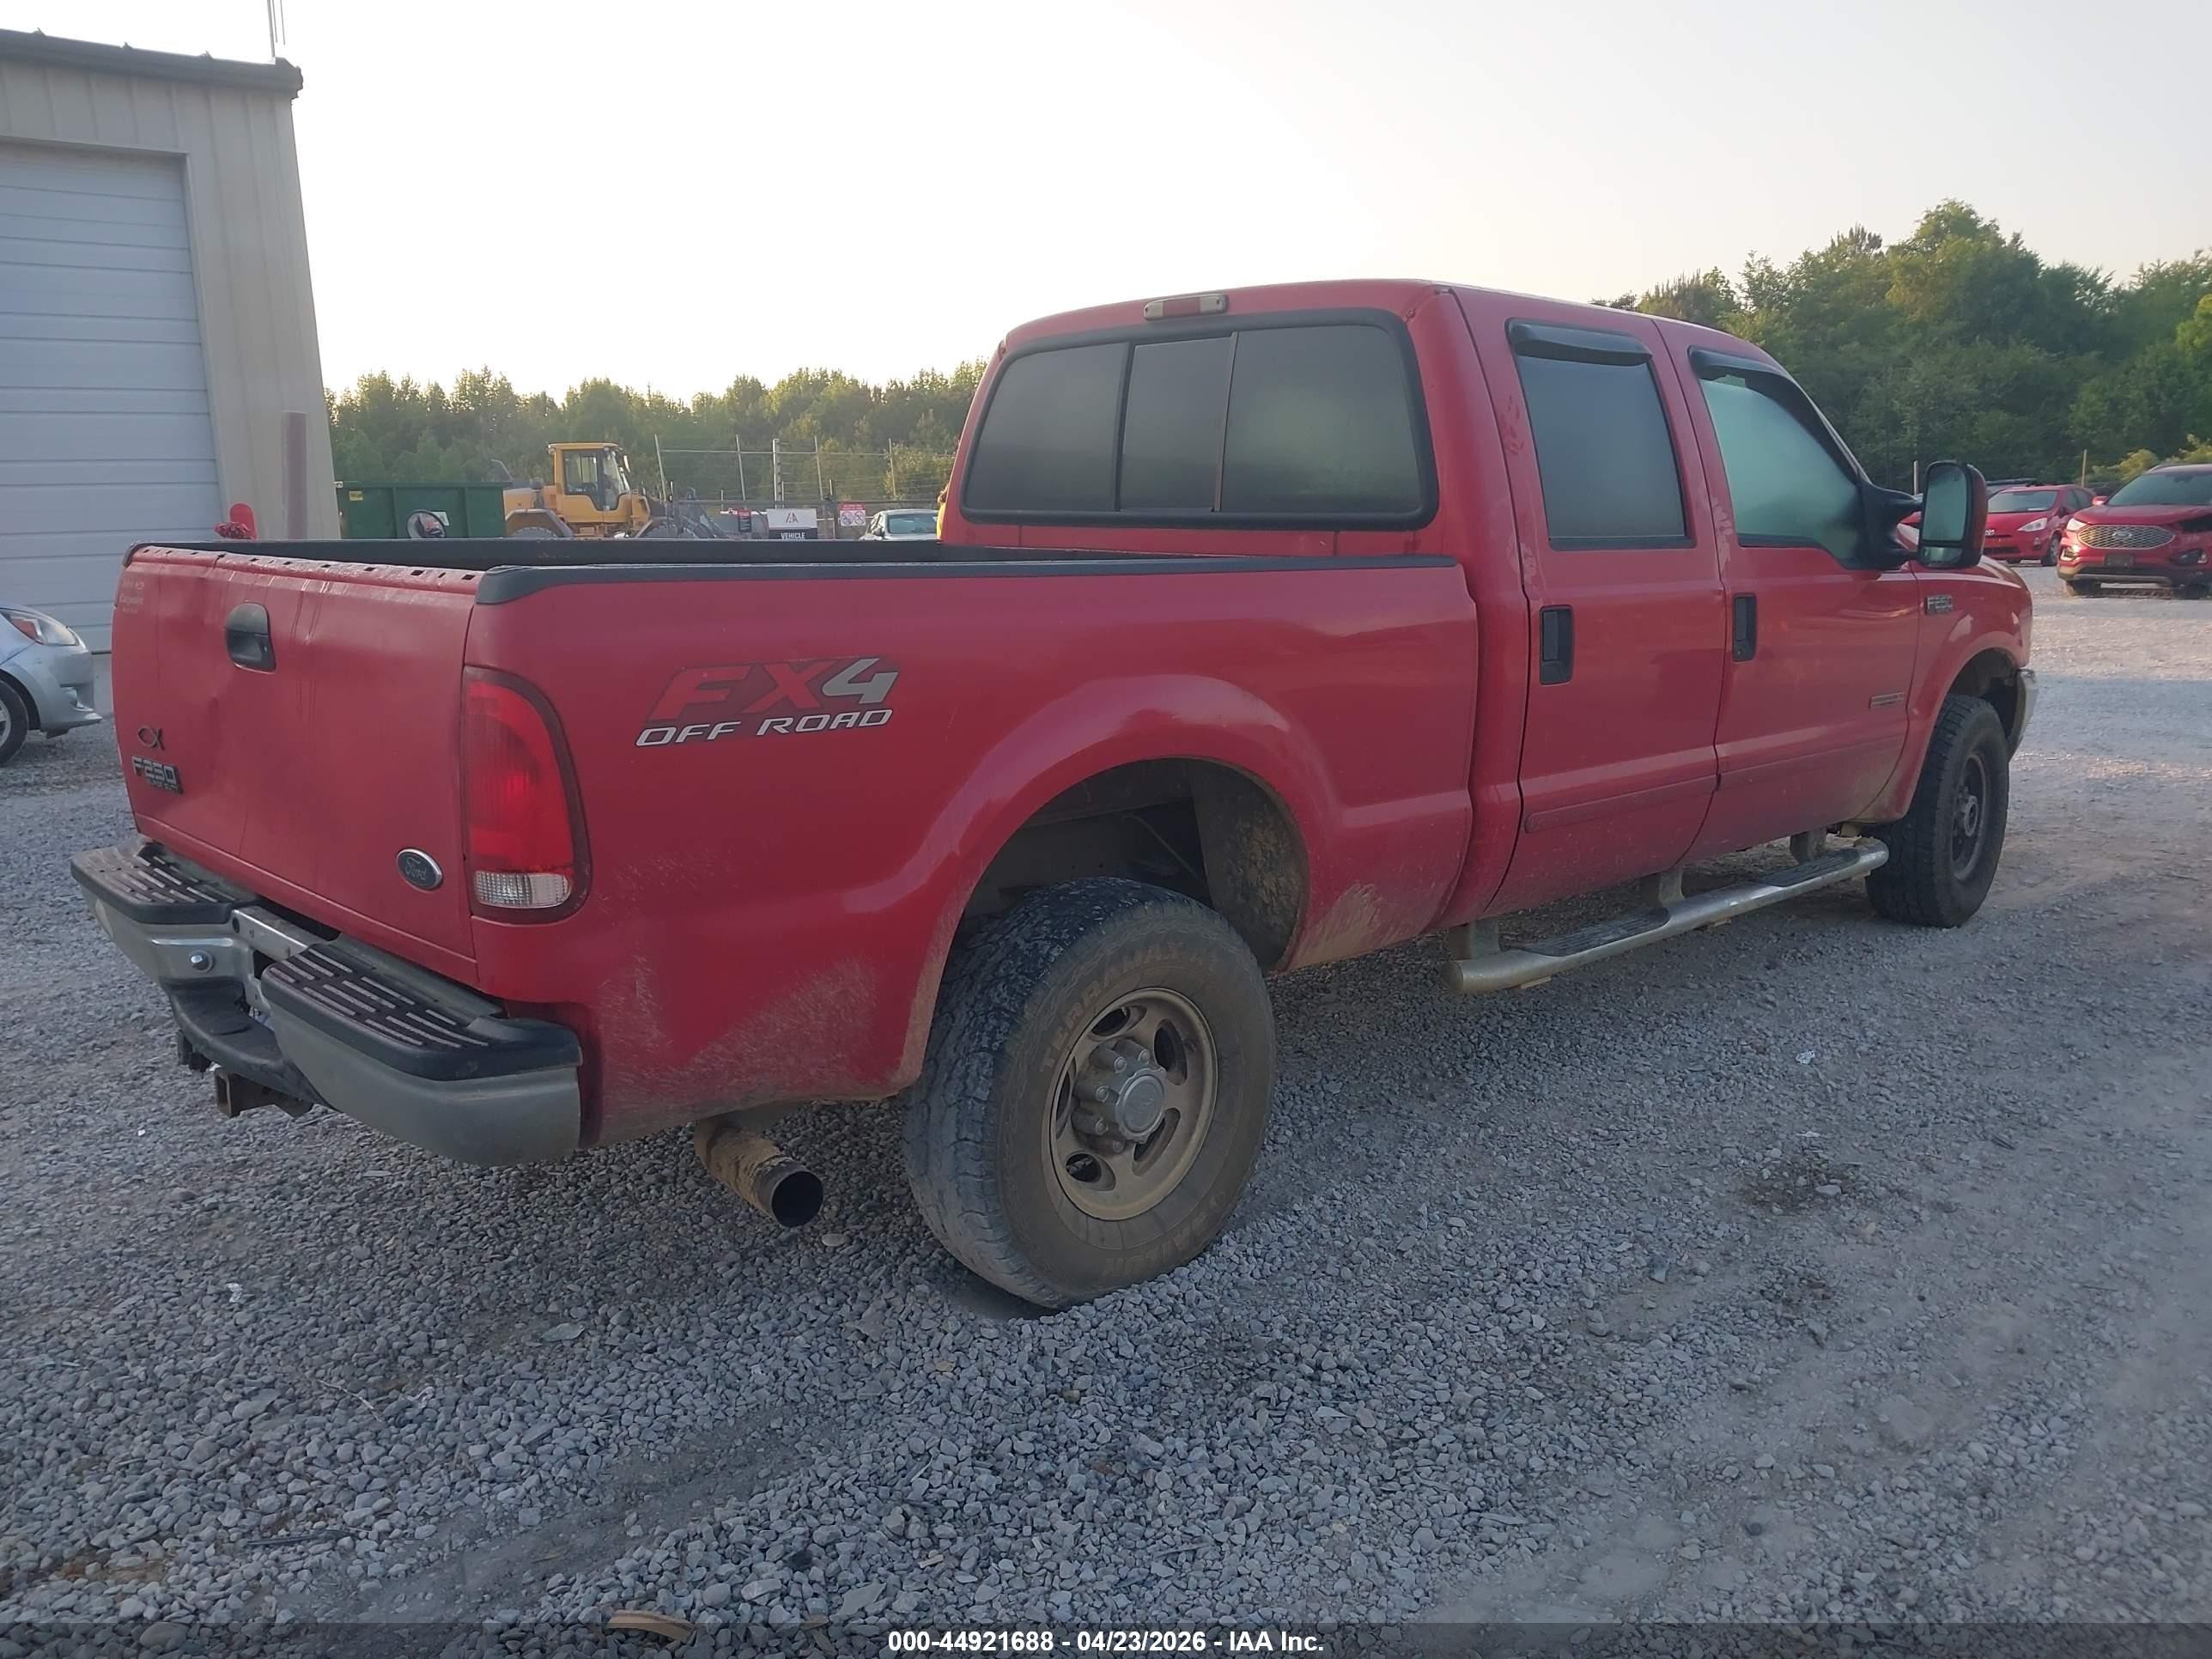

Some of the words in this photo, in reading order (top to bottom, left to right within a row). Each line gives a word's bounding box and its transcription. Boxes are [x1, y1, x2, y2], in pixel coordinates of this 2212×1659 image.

[781, 532, 805, 540] VEHICLE
[648, 658, 899, 721] FX4
[636, 720, 740, 746] OFF
[757, 708, 892, 736] ROAD
[404, 856, 428, 882] Ford
